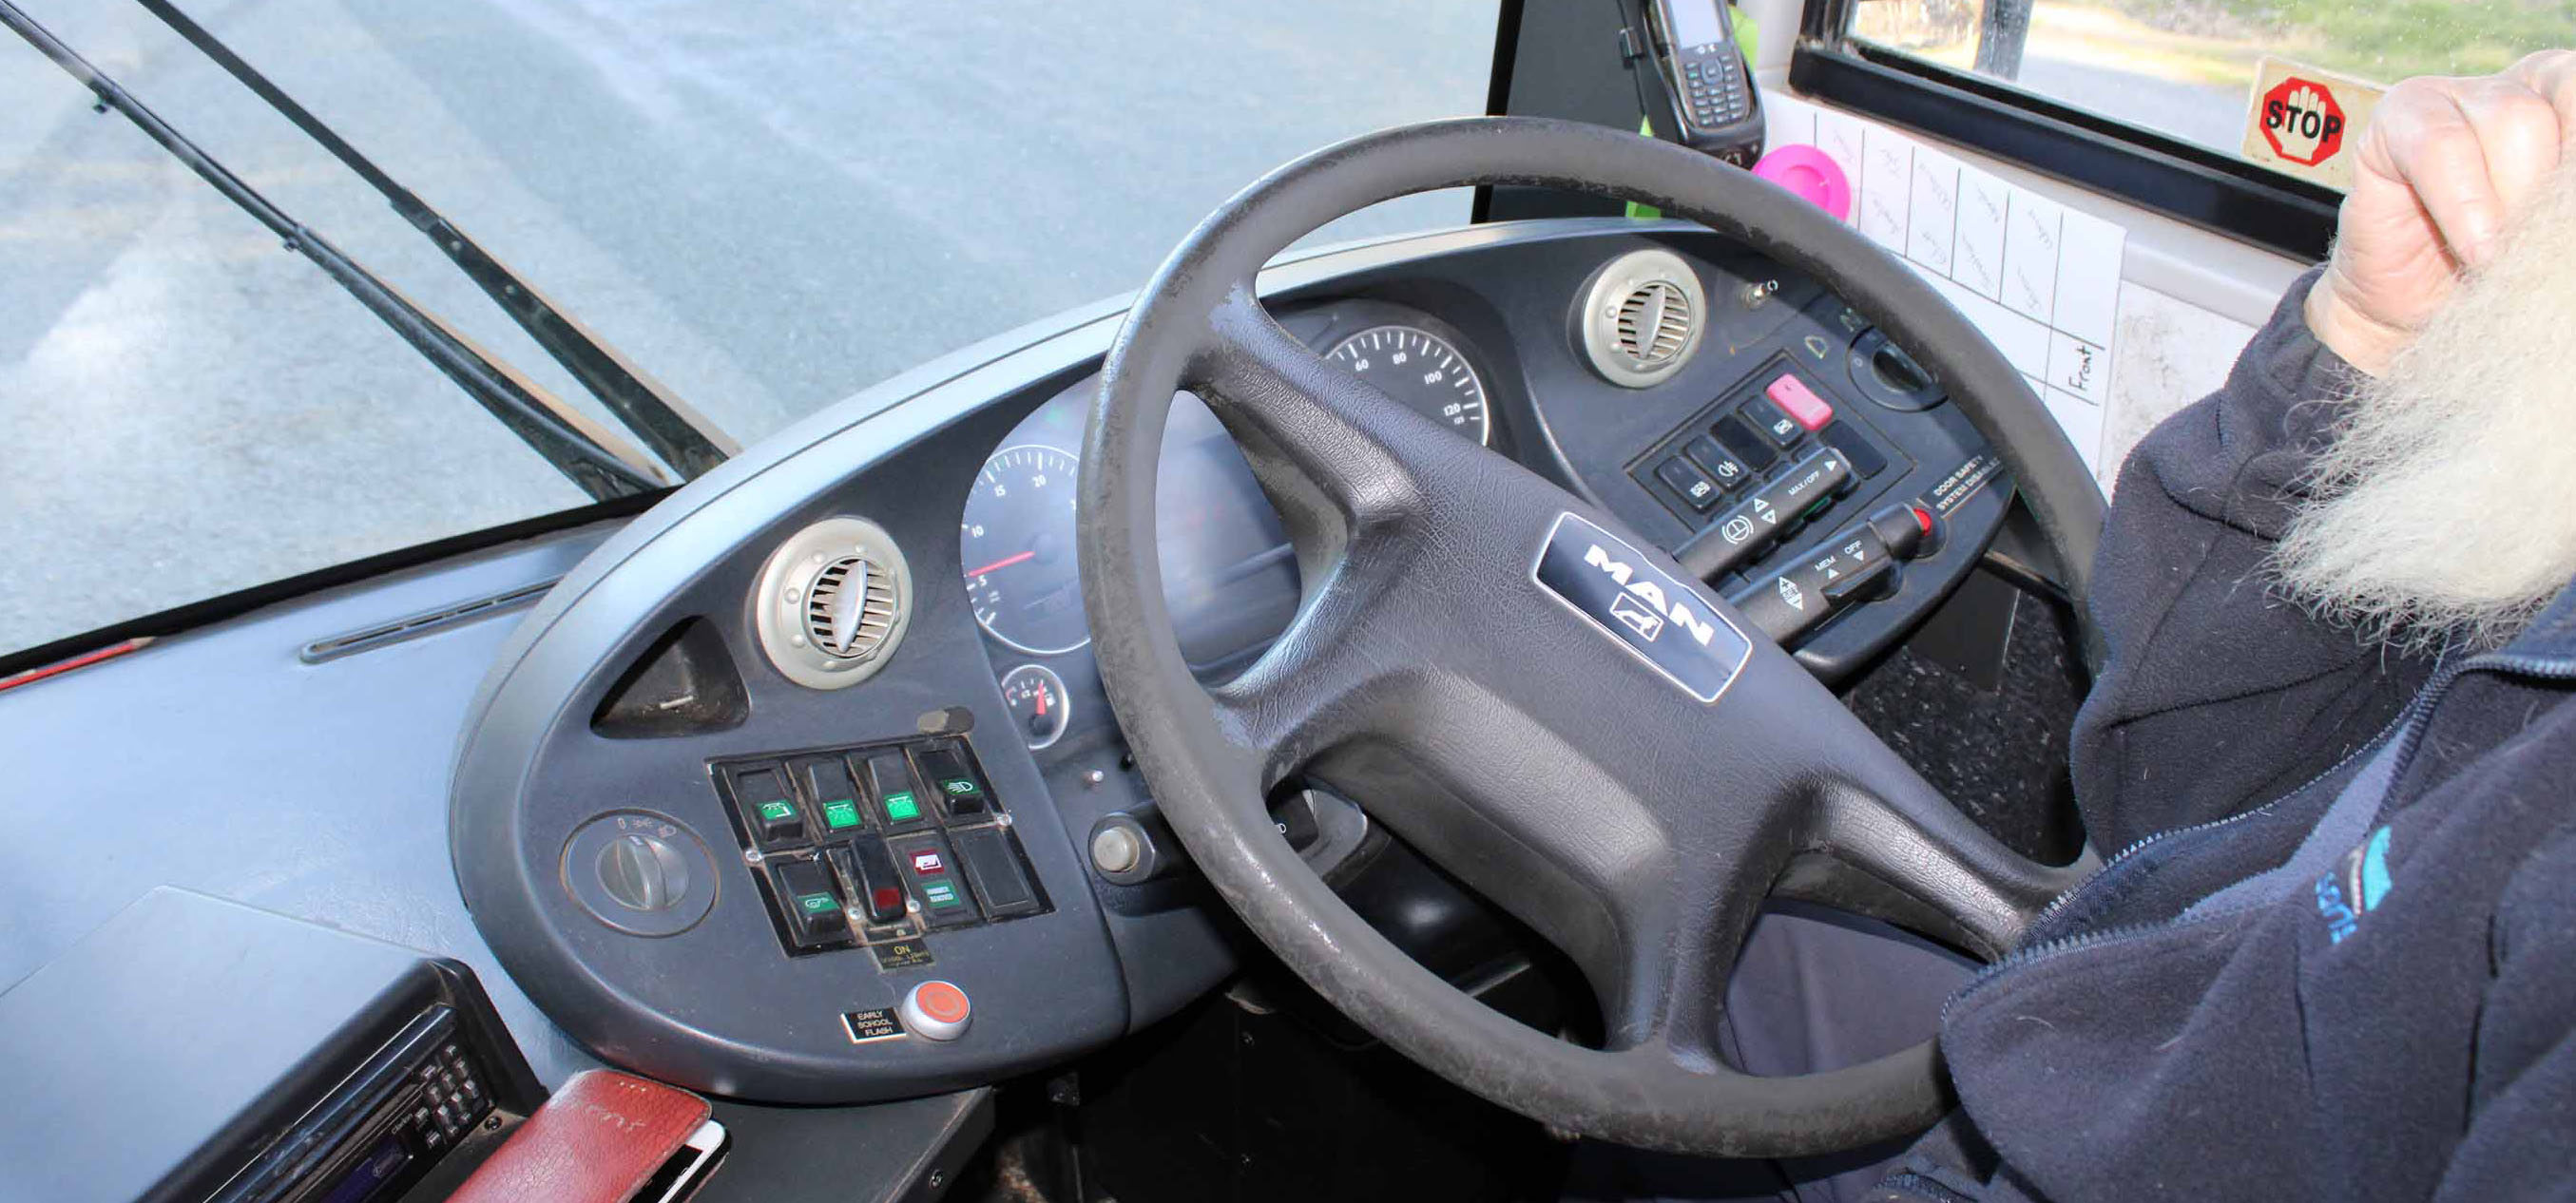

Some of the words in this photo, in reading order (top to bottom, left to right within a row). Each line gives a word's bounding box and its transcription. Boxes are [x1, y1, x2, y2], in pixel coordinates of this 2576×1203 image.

[2266, 100, 2342, 143] STOP
[1355, 358, 1370, 372] 60
[1393, 353, 1407, 365] 80
[1424, 371, 1442, 385] 100
[1444, 403, 1461, 416] 120
[1032, 474, 1047, 487] 20
[993, 485, 1006, 497] 15
[971, 525, 984, 538] 10
[1844, 540, 1863, 555] OFF
[1815, 555, 1836, 571] MEM
[978, 575, 988, 587] 5
[1584, 544, 1714, 646] MAN
[894, 945, 911, 955] ON
[857, 1010, 883, 1021] EARLY
[857, 1018, 894, 1029] SCHOOL
[864, 1026, 894, 1037] FLASH
